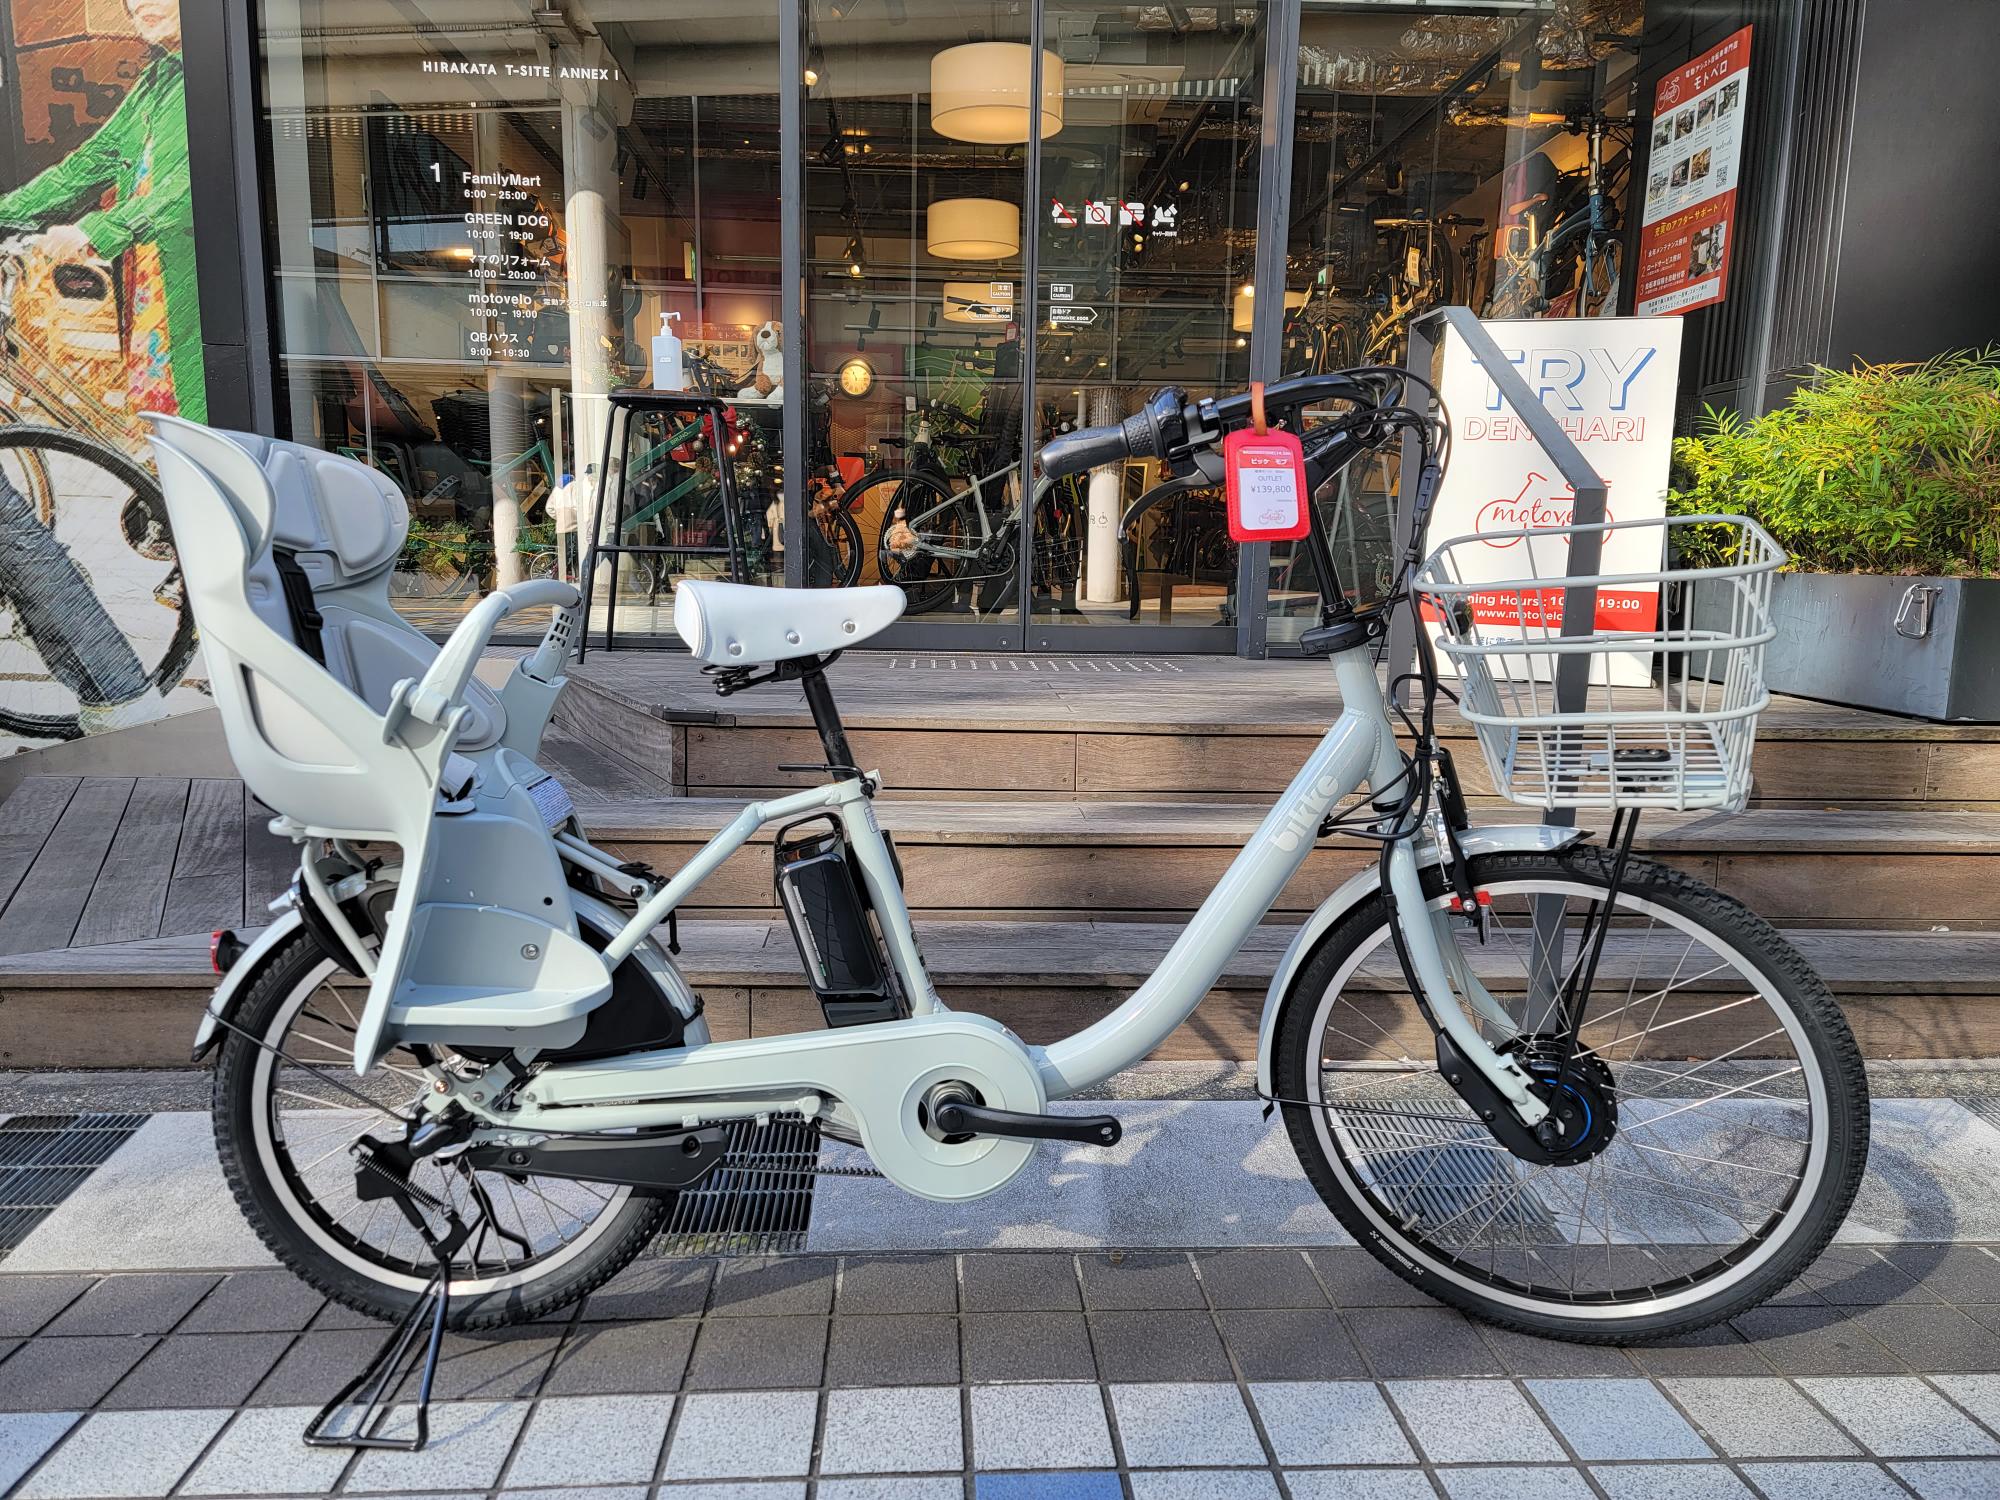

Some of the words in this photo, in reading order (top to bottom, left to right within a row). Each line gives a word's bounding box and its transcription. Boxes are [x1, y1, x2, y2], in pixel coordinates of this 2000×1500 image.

[423, 60, 497, 76] HIRAKATA
[505, 64, 550, 78] T-SITE
[560, 67, 608, 80] ANNEX
[1693, 60, 1728, 90] モトベロ
[429, 162, 441, 183] 1
[462, 171, 541, 188] FamilyMart
[464, 189, 487, 199] 6:00
[498, 190, 528, 201] 25:00
[464, 213, 513, 225] GREEN
[517, 213, 549, 227] DOG
[466, 230, 495, 240] 10:00
[508, 231, 534, 241] 19:00
[468, 254, 551, 267] ママのリフォーム
[467, 269, 497, 279] 10:00
[507, 270, 536, 280] 20:00
[468, 293, 532, 306] motovelo
[470, 308, 499, 317] 10:00
[512, 309, 538, 319] 19:00
[470, 331, 519, 344] QBハウス
[470, 347, 492, 357] 9:00
[502, 348, 530, 358] 19:30
[1471, 347, 1657, 411] TRY
[1463, 416, 1646, 442] DENHARI
[1250, 485, 1292, 494] ¥139,800
[1500, 595, 1539, 606] Hours
[1598, 598, 1640, 609] 19:00
[1377, 1237, 1415, 1270] BRIDGESTONE
